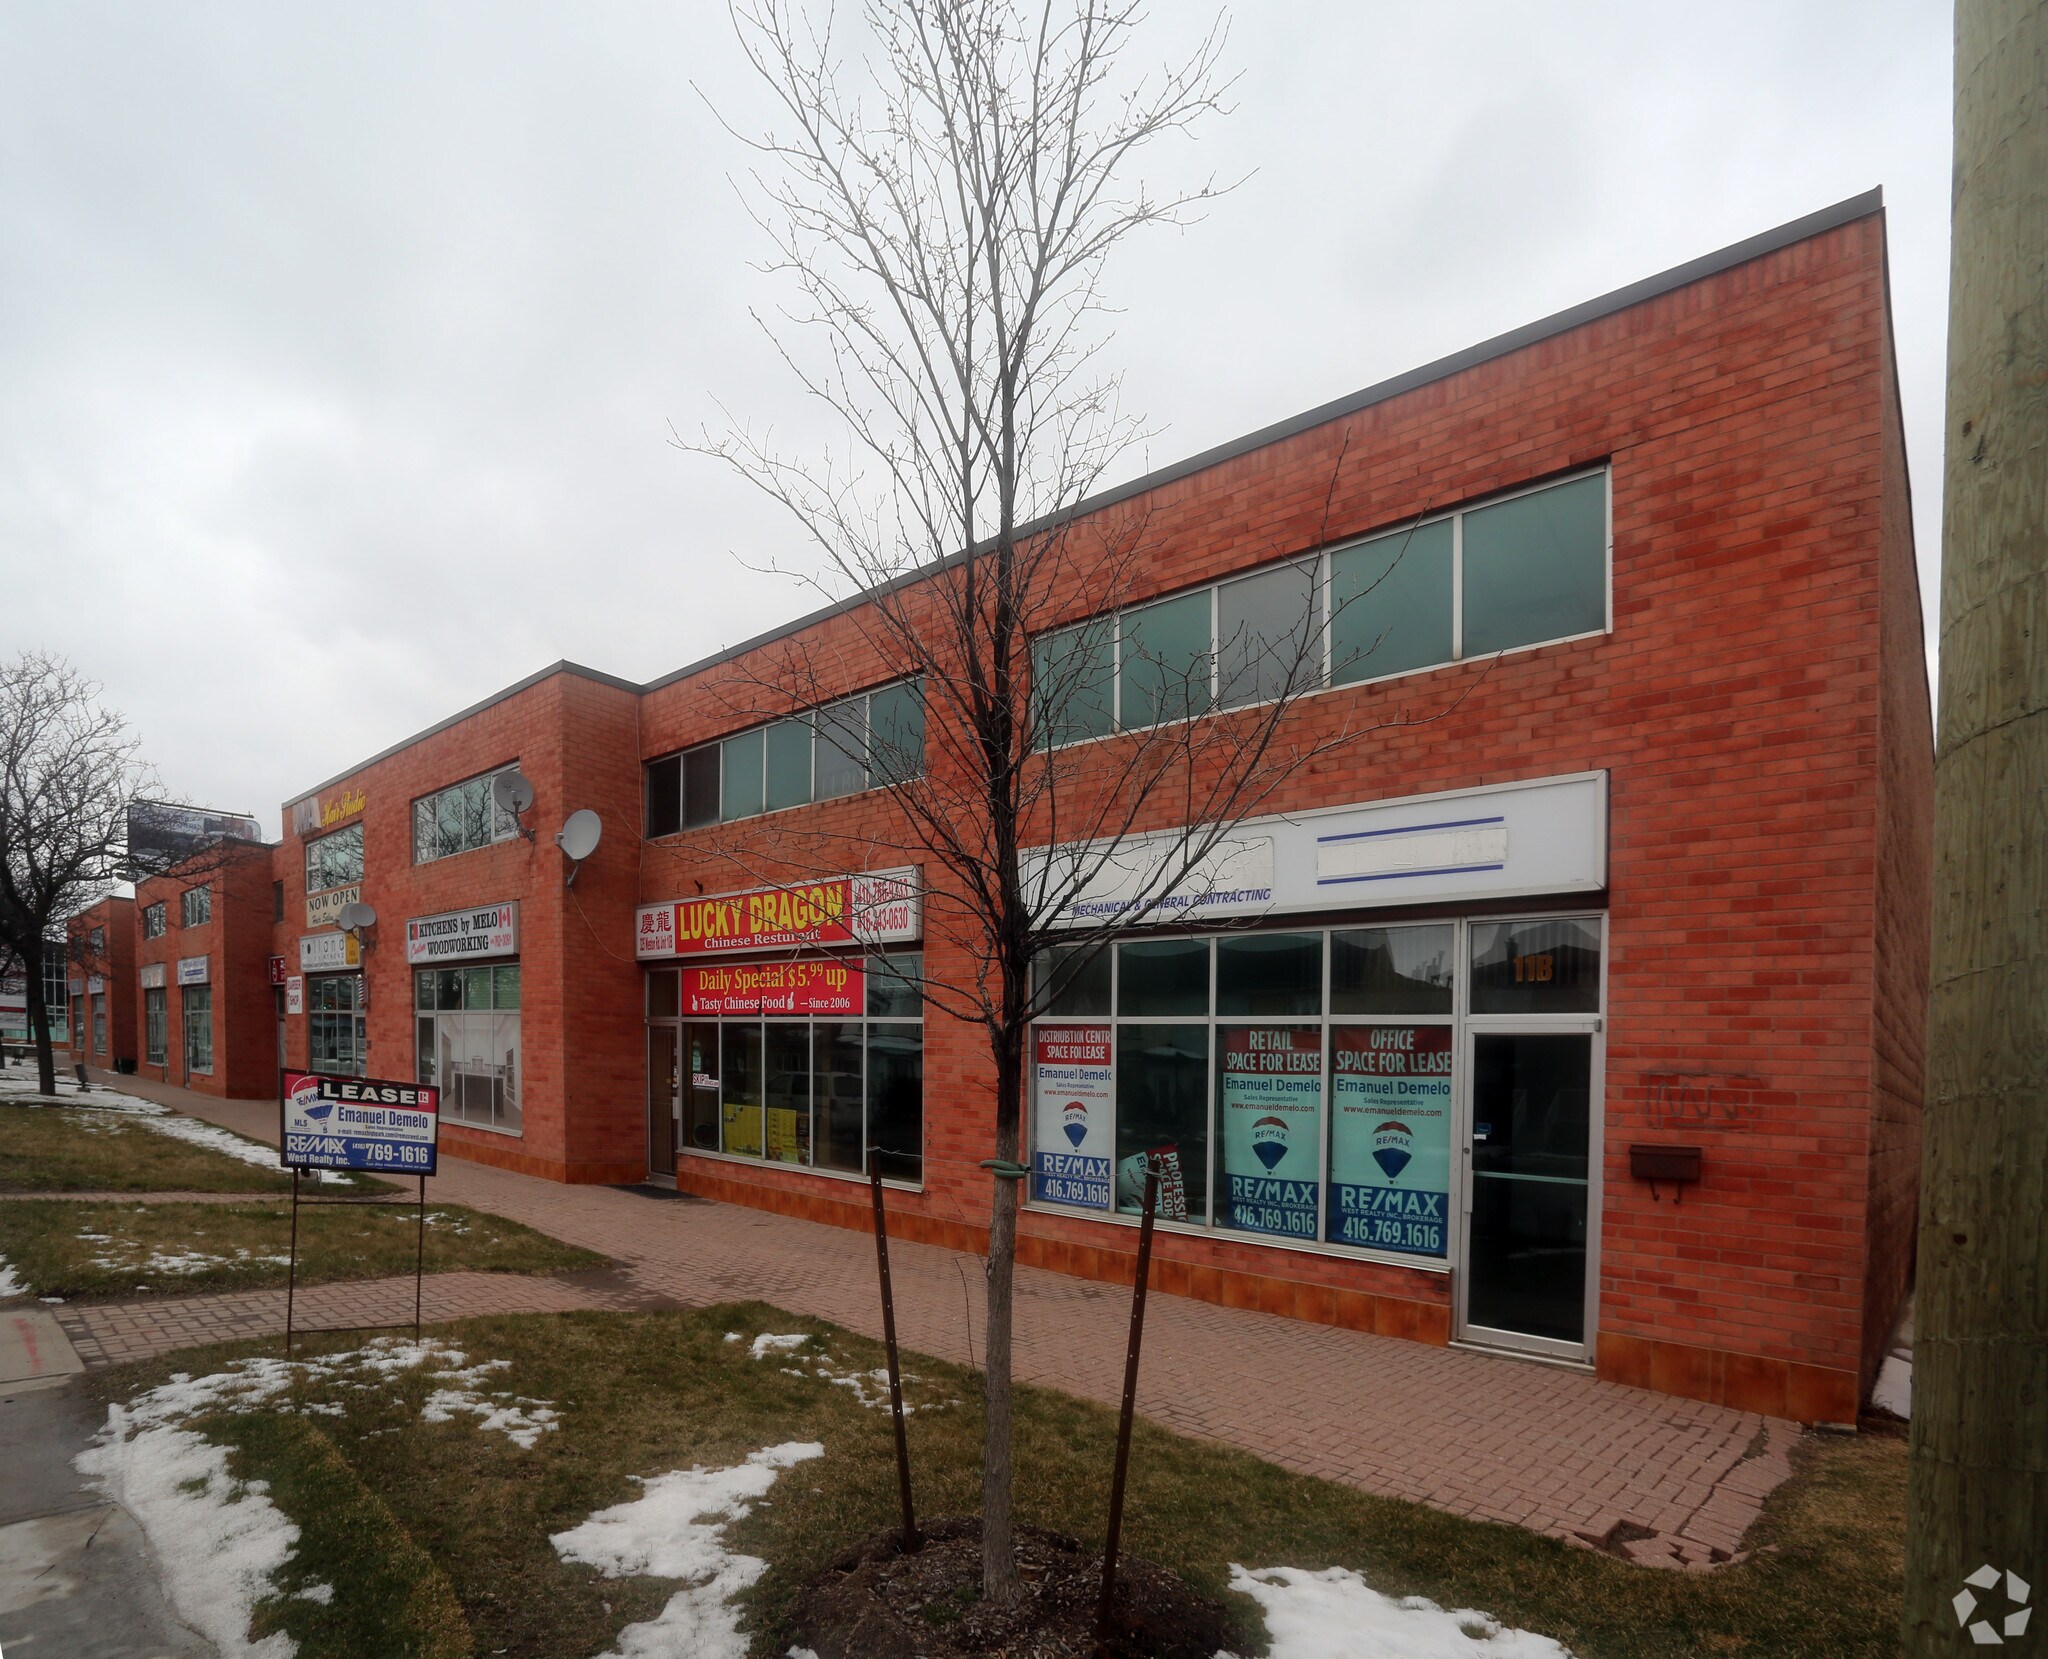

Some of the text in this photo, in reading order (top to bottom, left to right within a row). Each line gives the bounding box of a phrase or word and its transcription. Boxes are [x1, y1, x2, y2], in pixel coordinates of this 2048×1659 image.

[309, 888, 358, 912] NOW OPEN
[1072, 900, 1132, 916] MECHANICAL
[1134, 900, 1141, 911] &
[1193, 888, 1271, 906] CONTRACTING
[680, 884, 843, 940] LUCKY DRAGON
[419, 912, 497, 938] KITCHENS by MELO
[640, 911, 672, 934] 慶龍
[427, 935, 489, 956] WOODWORKING
[704, 936, 750, 949] Chinese
[1514, 954, 1553, 982] 11B
[699, 969, 732, 995] Daily
[735, 965, 784, 995] Special
[826, 967, 847, 992] up
[700, 997, 722, 1012] Tasty
[724, 996, 760, 1010] Chinese
[761, 995, 785, 1009] Food
[830, 997, 850, 1008] 2006
[1249, 1030, 1294, 1051] RETAIL
[1370, 1029, 1415, 1051] OFFICE
[1047, 1045, 1068, 1059] SPACE
[1083, 1045, 1105, 1059] LEASE
[1227, 1052, 1320, 1072] SPACE FOR LEASE
[1336, 1050, 1452, 1073] SPACE FOR LEASE
[1039, 1067, 1077, 1079] Emanuel
[324, 1083, 416, 1104] LEASE
[1044, 1089, 1109, 1098] www.emanueldemelo.com
[1225, 1077, 1321, 1093] Emanuel Demelo
[1336, 1079, 1451, 1096] Emanuel Demelo
[296, 1093, 319, 1106] RE/MA
[1231, 1102, 1315, 1112] www.emanueldemelo.com
[1259, 1094, 1298, 1102] Representative
[1363, 1097, 1424, 1106] Sales Representative
[338, 1107, 428, 1129] Emanuel Demelo
[1065, 1113, 1086, 1122] RE/MAX
[1343, 1106, 1442, 1117] www.emanueldemelo.com
[294, 1119, 308, 1127] MLS
[287, 1135, 347, 1155] RE/MAX
[1255, 1130, 1286, 1140] RE/MAX
[1376, 1136, 1410, 1148] RE/MAX
[287, 1153, 350, 1166] West Realty Inc.
[365, 1143, 428, 1163] 769-1616
[1043, 1154, 1108, 1178] RE/MAX
[1045, 1178, 1109, 1204] 416.769.1616
[1232, 1176, 1314, 1204] RE/MAX
[1163, 1192, 1174, 1217] FOR
[1281, 1202, 1318, 1211] BROKERAGE
[1341, 1186, 1440, 1217] RE/MAX
[1234, 1204, 1316, 1234] 416.769.1616
[1360, 1209, 1385, 1217] REALTY
[1402, 1213, 1444, 1224] BROKERAGE
[1342, 1216, 1440, 1249] 416.769.1616
